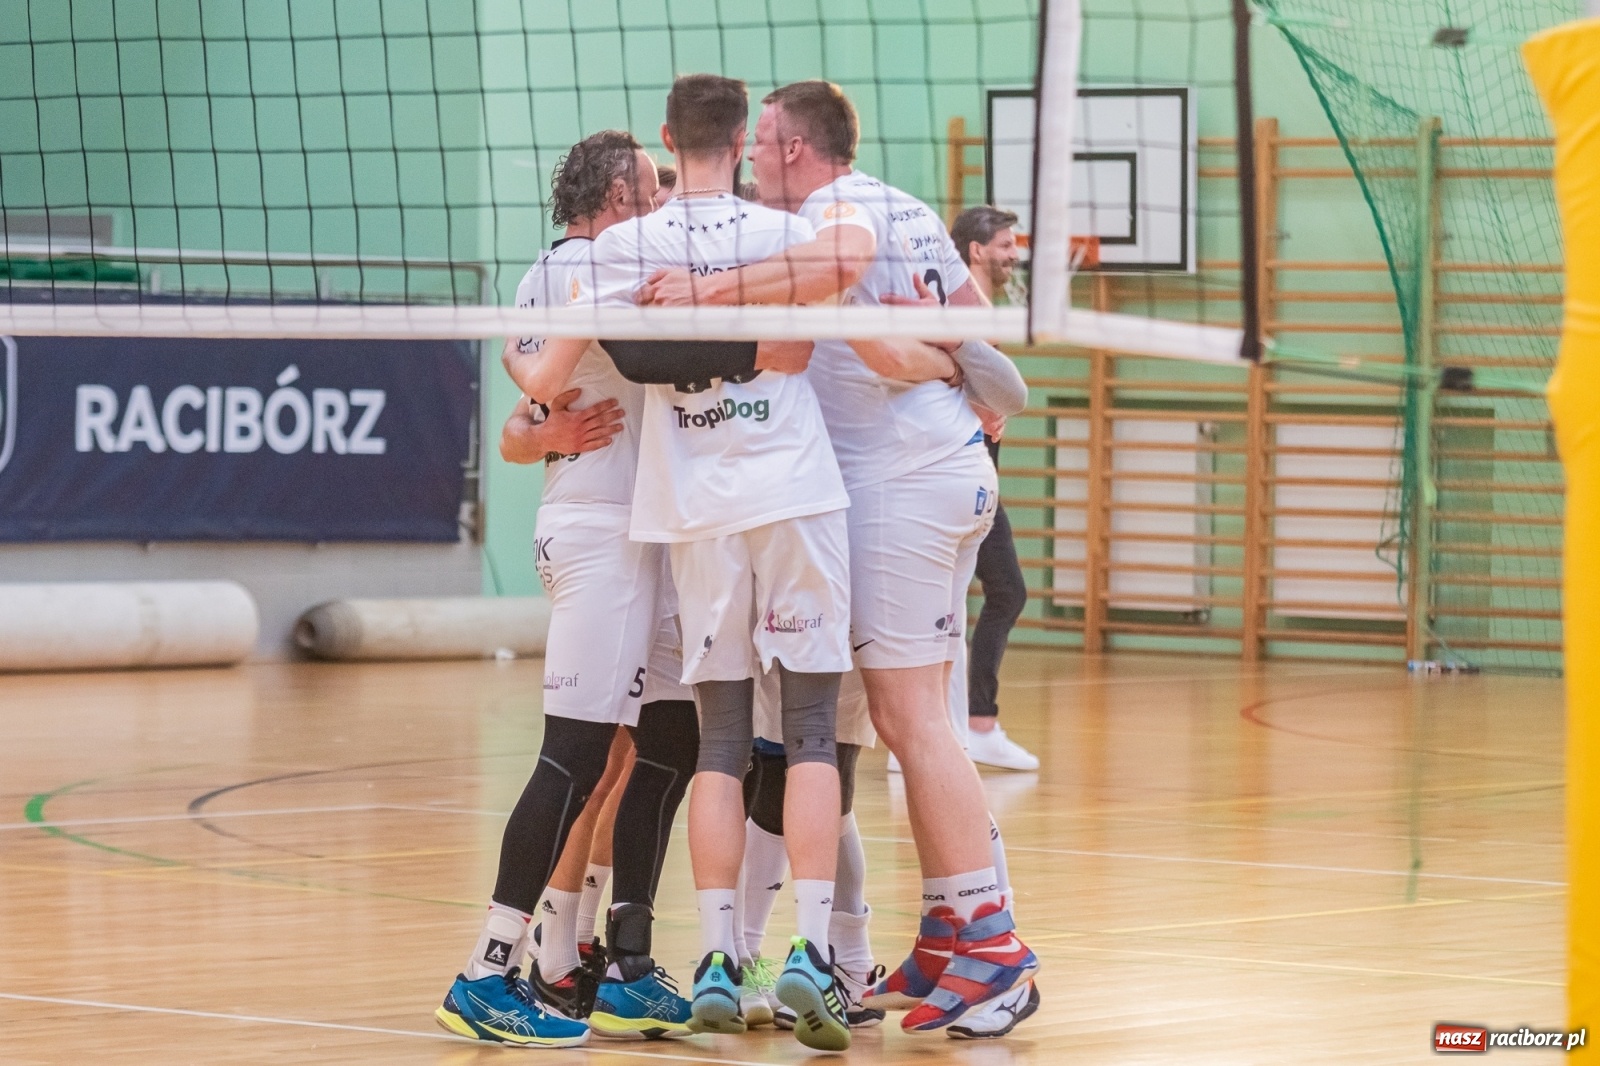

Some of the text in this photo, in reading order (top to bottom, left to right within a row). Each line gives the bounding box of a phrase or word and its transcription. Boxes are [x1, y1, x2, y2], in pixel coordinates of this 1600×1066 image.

[74, 364, 387, 455] RACIBÓRZ
[673, 398, 770, 429] TropiDog
[776, 613, 823, 633] kolgraf
[545, 671, 579, 689] olgraf
[627, 666, 646, 699] 5
[958, 884, 998, 897] GIOCC
